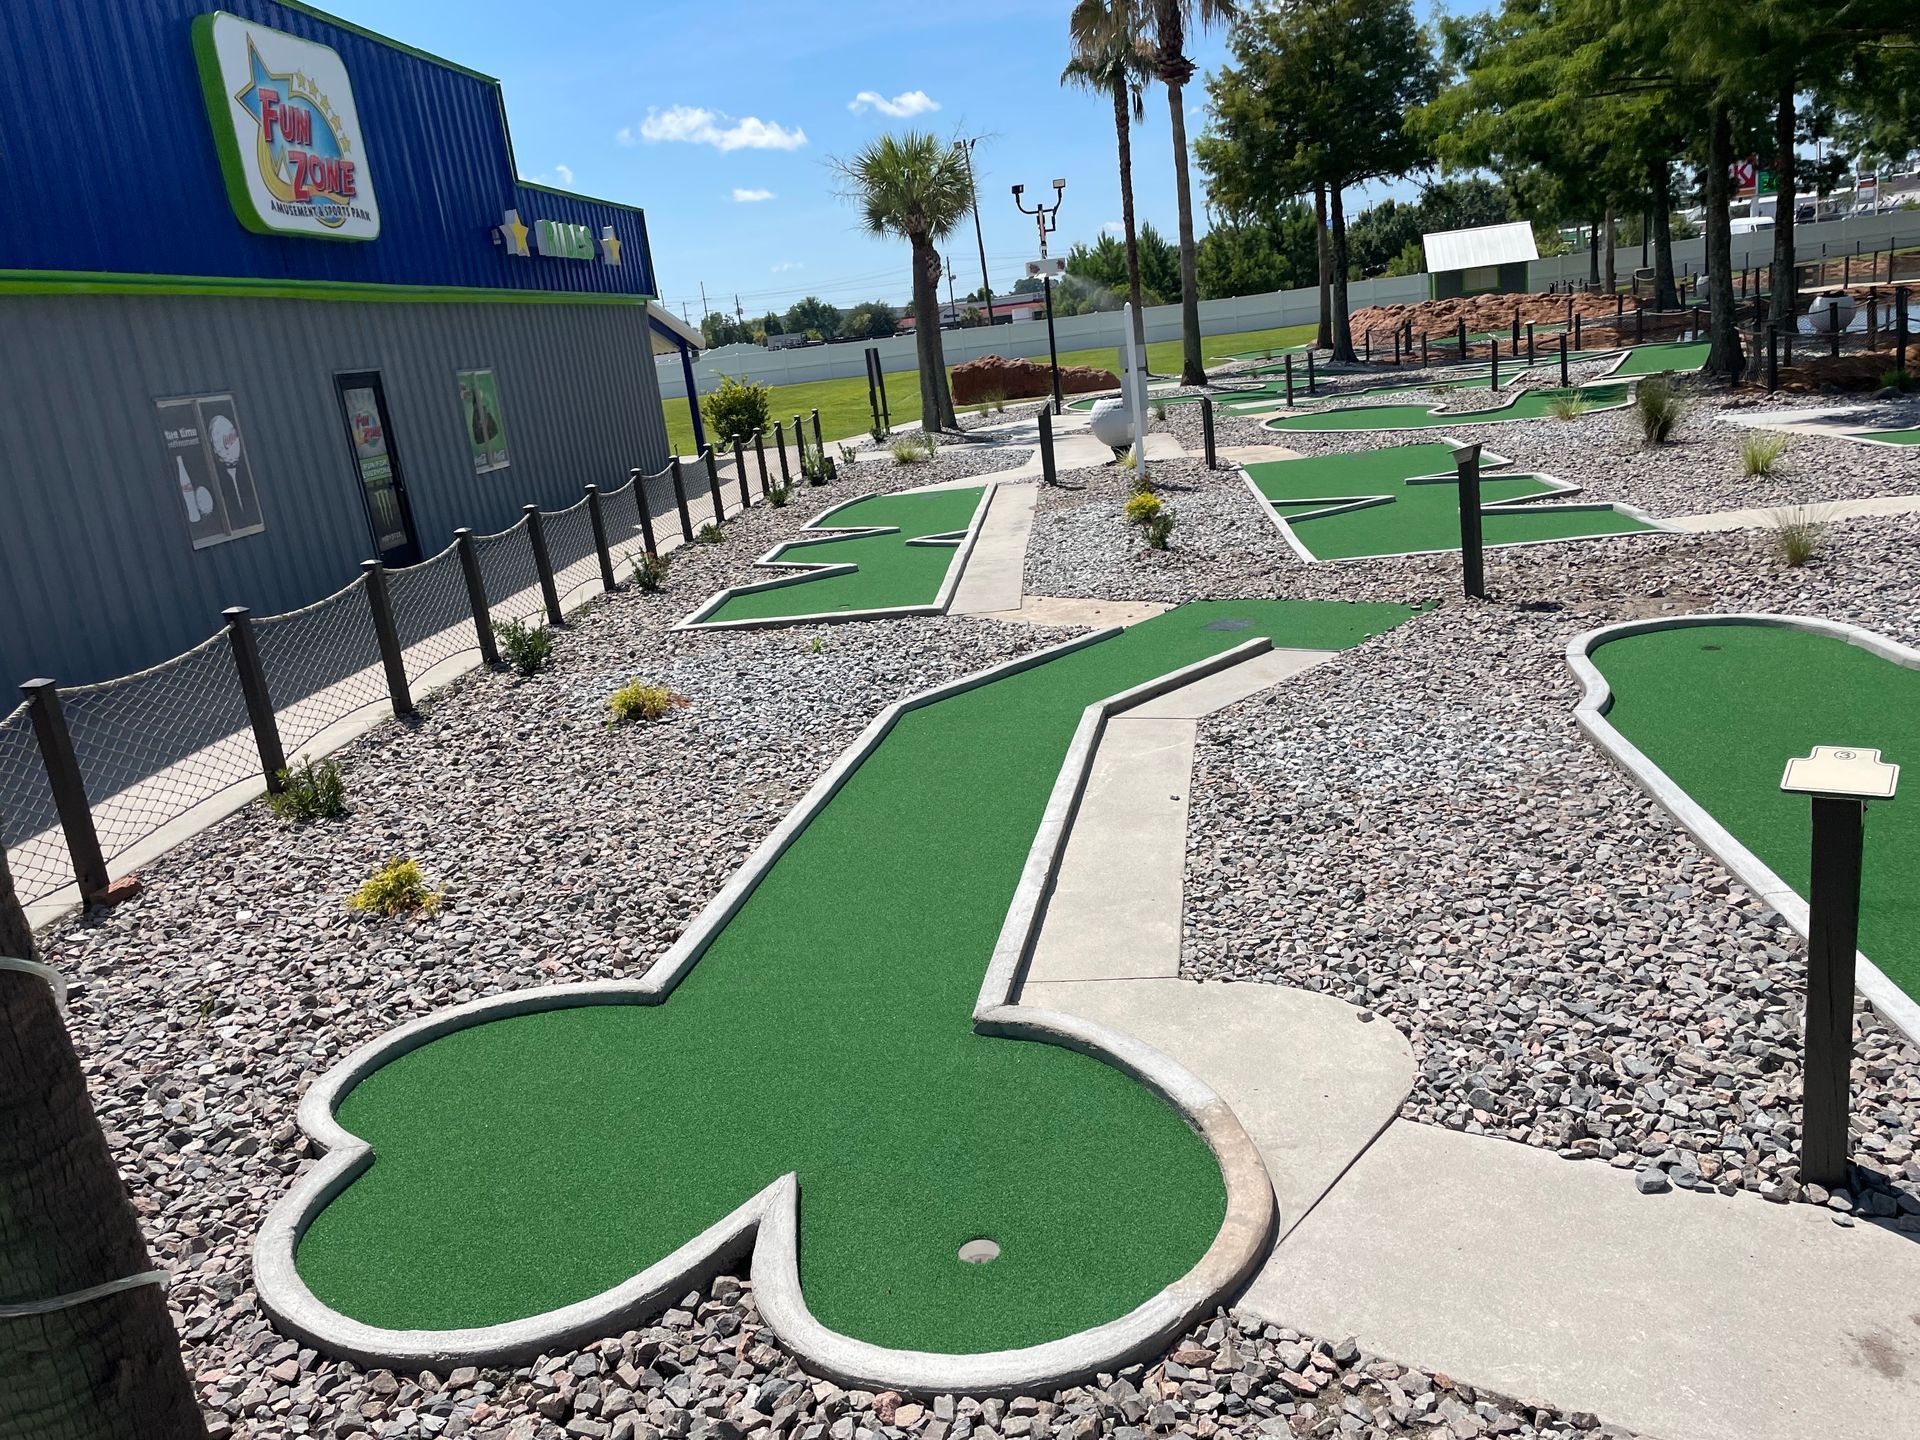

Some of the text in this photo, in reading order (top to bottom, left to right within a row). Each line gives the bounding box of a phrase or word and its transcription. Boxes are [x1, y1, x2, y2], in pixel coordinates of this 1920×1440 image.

[259, 88, 311, 146] FUN
[288, 150, 356, 201] ZONE
[271, 200, 316, 218] AMUSEMENT
[325, 205, 351, 217] SPORTS
[351, 207, 372, 222] PARK
